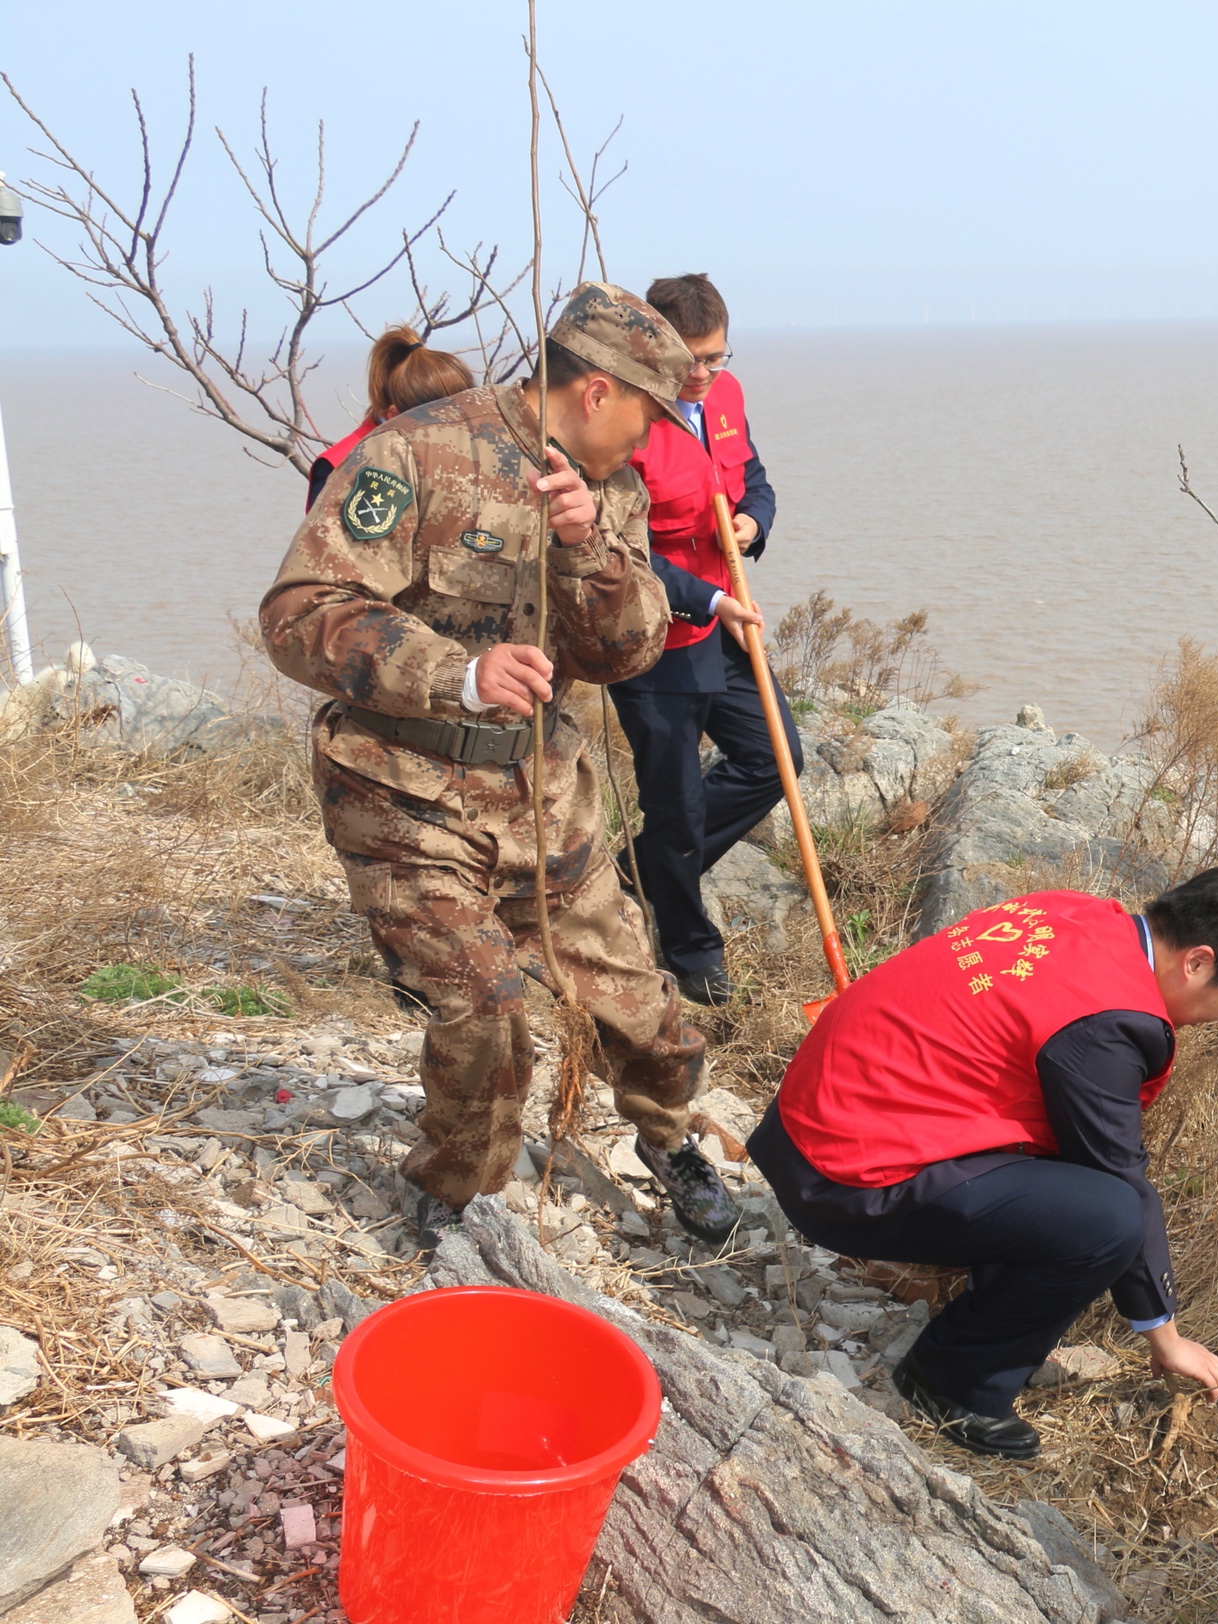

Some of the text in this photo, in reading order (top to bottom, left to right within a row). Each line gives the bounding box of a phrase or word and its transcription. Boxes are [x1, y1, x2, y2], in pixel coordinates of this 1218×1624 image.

[365, 470, 410, 495] 中华人民共和国
[370, 481, 396, 498] 民兵
[947, 918, 994, 995] 务志愿者
